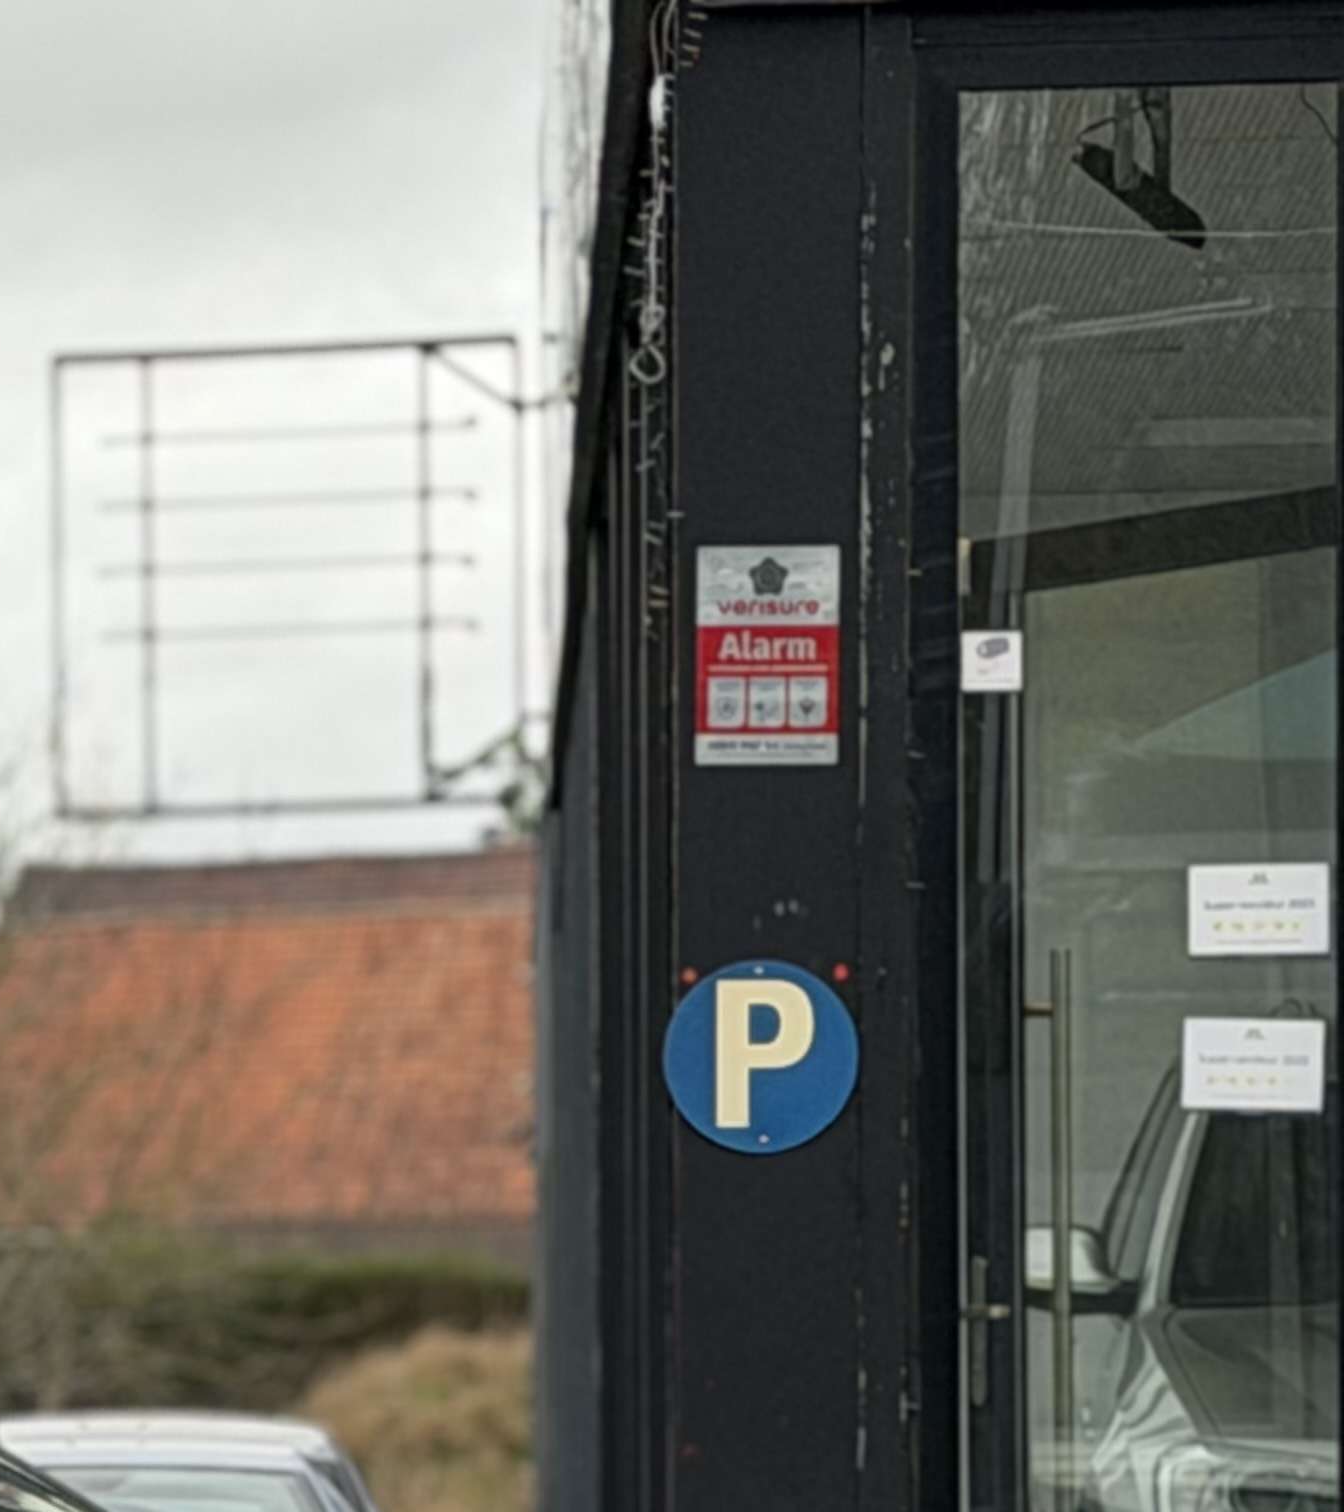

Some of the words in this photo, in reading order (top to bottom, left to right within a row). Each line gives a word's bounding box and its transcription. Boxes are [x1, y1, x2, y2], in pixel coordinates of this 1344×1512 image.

[718, 599, 820, 616] verisure
[717, 631, 817, 660] Alarm
[716, 979, 815, 1128] P
